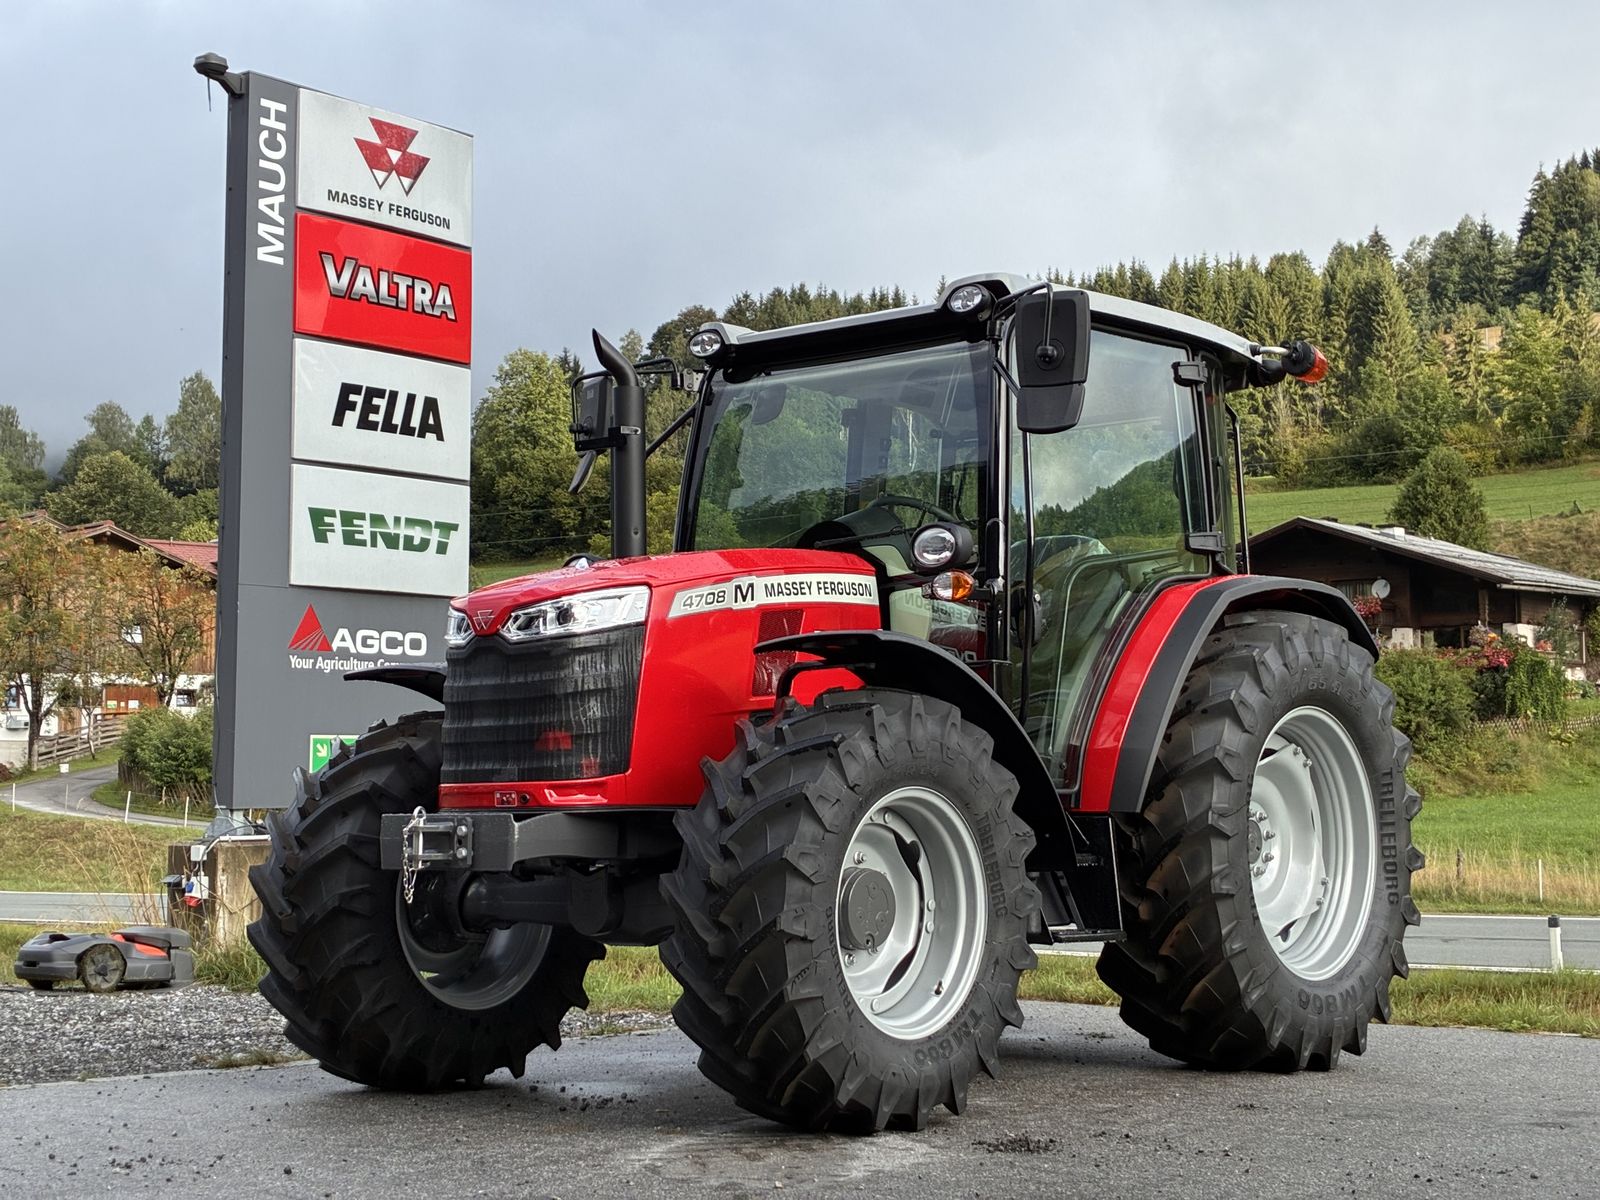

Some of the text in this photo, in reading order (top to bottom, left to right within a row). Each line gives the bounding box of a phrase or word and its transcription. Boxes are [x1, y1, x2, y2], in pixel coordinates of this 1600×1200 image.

[256, 97, 287, 265] MAUCH
[327, 189, 451, 231] MASSEY FERGUSON
[319, 250, 458, 322] VALTRA
[331, 382, 445, 442] FELLA
[307, 506, 460, 556] FENDT
[681, 580, 873, 609] 4708 M MASSEY FERGUSON
[289, 655, 314, 669] Your
[315, 656, 375, 673] Agriculture
[332, 627, 428, 657] AGCO
[1380, 767, 1399, 905] TRELLEBORG
[975, 811, 1009, 918] TRELLEBORG
